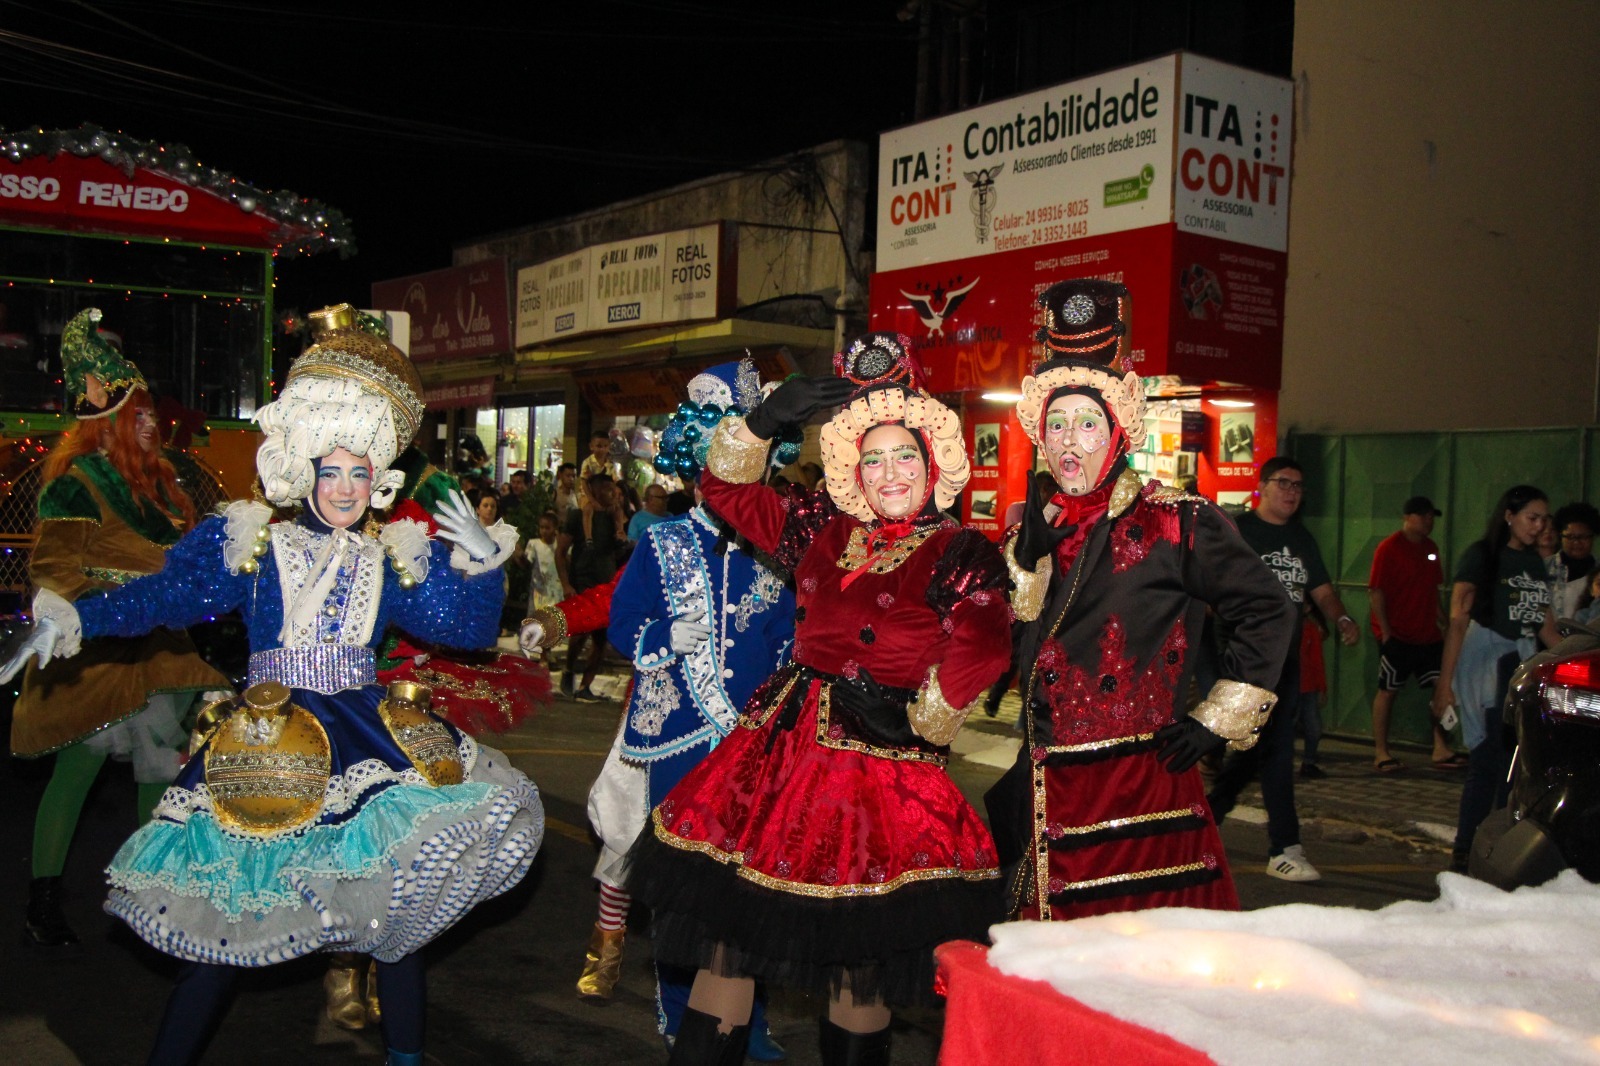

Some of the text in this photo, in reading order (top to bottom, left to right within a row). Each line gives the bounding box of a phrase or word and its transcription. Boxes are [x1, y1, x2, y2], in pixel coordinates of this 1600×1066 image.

[963, 77, 1159, 160] Contabilidade
[1184, 93, 1243, 147] ITA
[1013, 128, 1156, 174] Assessorando Clientes desde 1991
[892, 151, 929, 188] ITA
[1180, 147, 1285, 206] CONT
[78, 180, 189, 213] PENEDO
[890, 182, 957, 226] CONT
[993, 198, 1089, 231] Celular: 24 99316-8025
[1203, 198, 1253, 218] ASSESSORIA
[904, 222, 937, 236] ASSESSORIA
[1184, 213, 1227, 233] CONTÁBIL
[994, 220, 1088, 251] Telefone: 24 3352-1443
[610, 243, 658, 264] REAL FOTOS
[677, 243, 708, 264] REAL
[598, 265, 661, 299] PAPELARIA
[672, 263, 711, 285] FOTOS
[523, 280, 539, 294] REAL
[520, 295, 541, 313] FOTOS
[609, 304, 640, 321] XEROX
[1217, 467, 1254, 476] TROCA DE TELA
[1508, 605, 1545, 623] Bras
